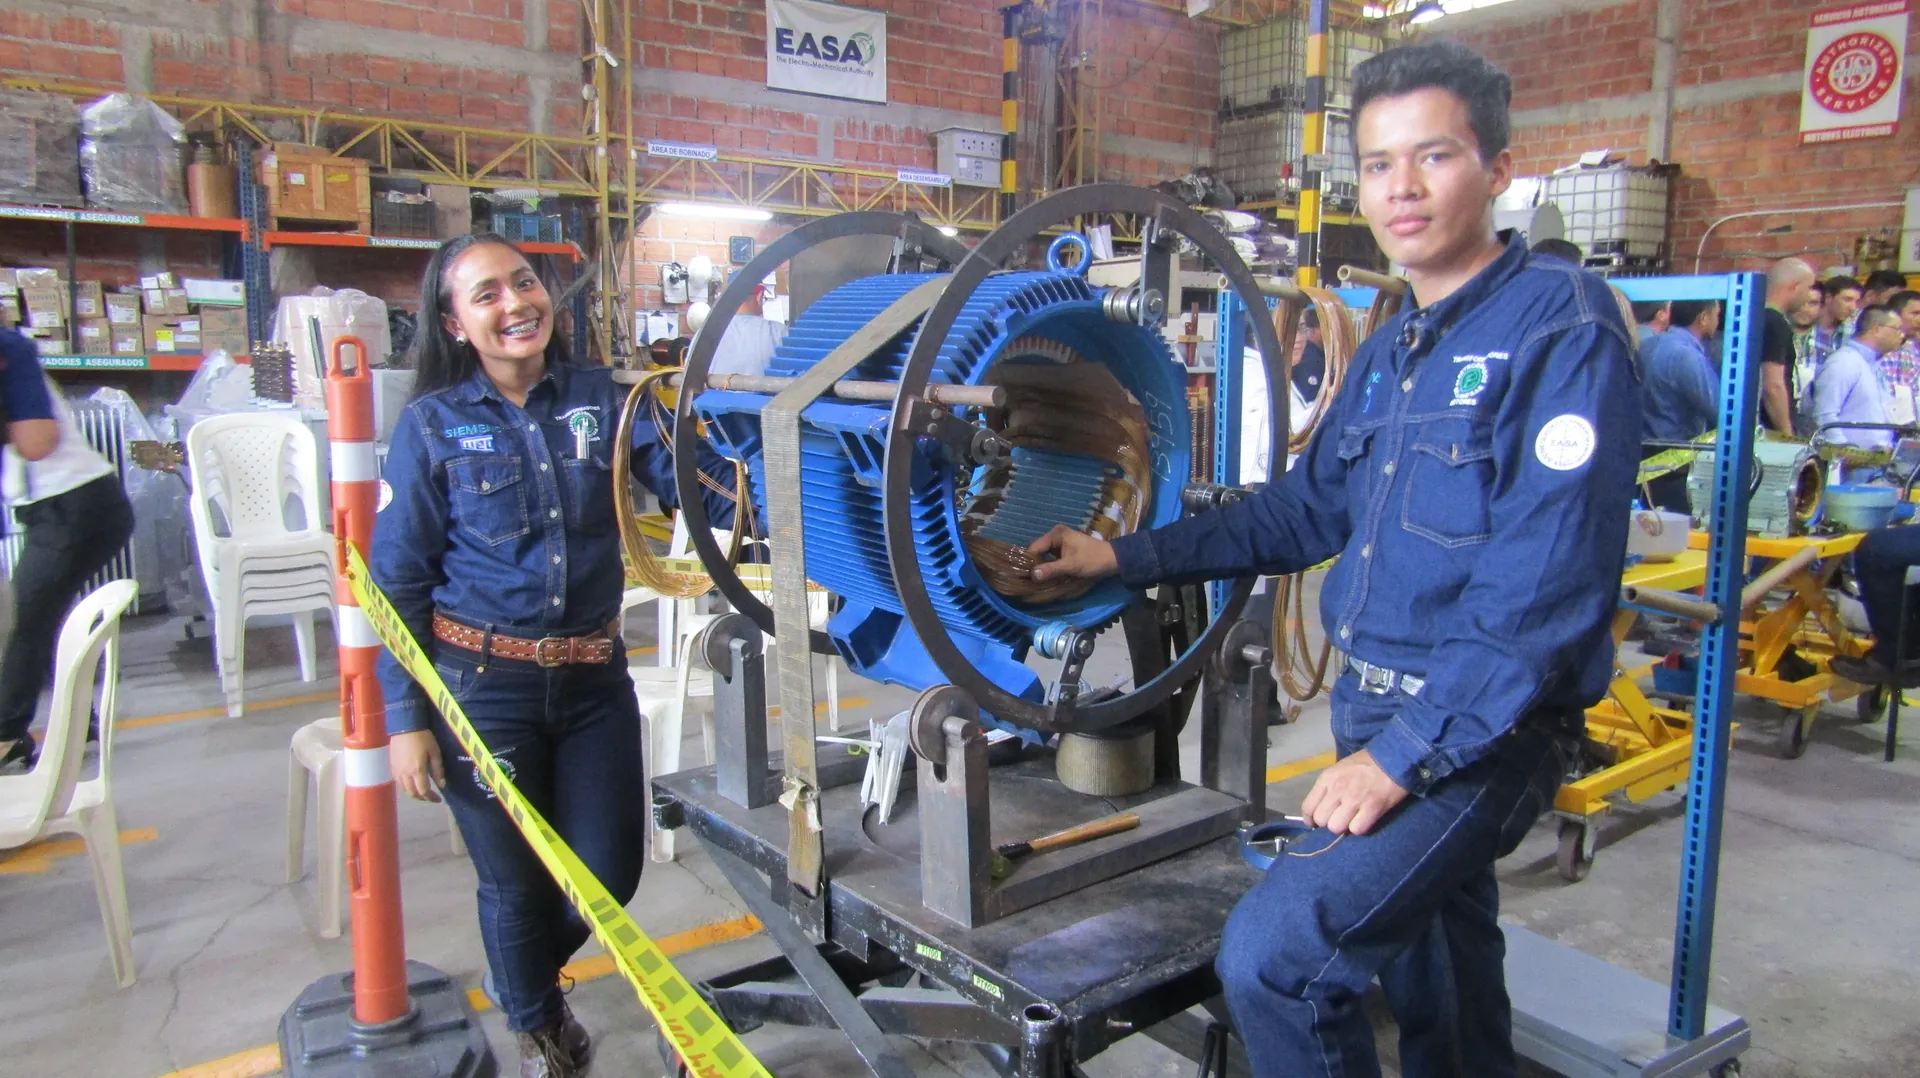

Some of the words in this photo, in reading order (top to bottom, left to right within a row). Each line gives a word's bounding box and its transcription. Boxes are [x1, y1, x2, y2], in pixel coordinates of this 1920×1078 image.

[775, 27, 864, 65] EASA
[1815, 35, 1893, 75] AUTHORIZED
[776, 56, 787, 64] The
[788, 57, 848, 73] Electro-Mechanical
[849, 67, 874, 77] Authority
[1816, 79, 1888, 110] SERVICE
[679, 148, 710, 158] BOBINADO
[81, 214, 140, 224] ASEGURADOS
[371, 238, 442, 249] TRANSFORMADORES
[85, 358, 145, 367] ASEGURADOS
[1549, 439, 1578, 447] EASA
